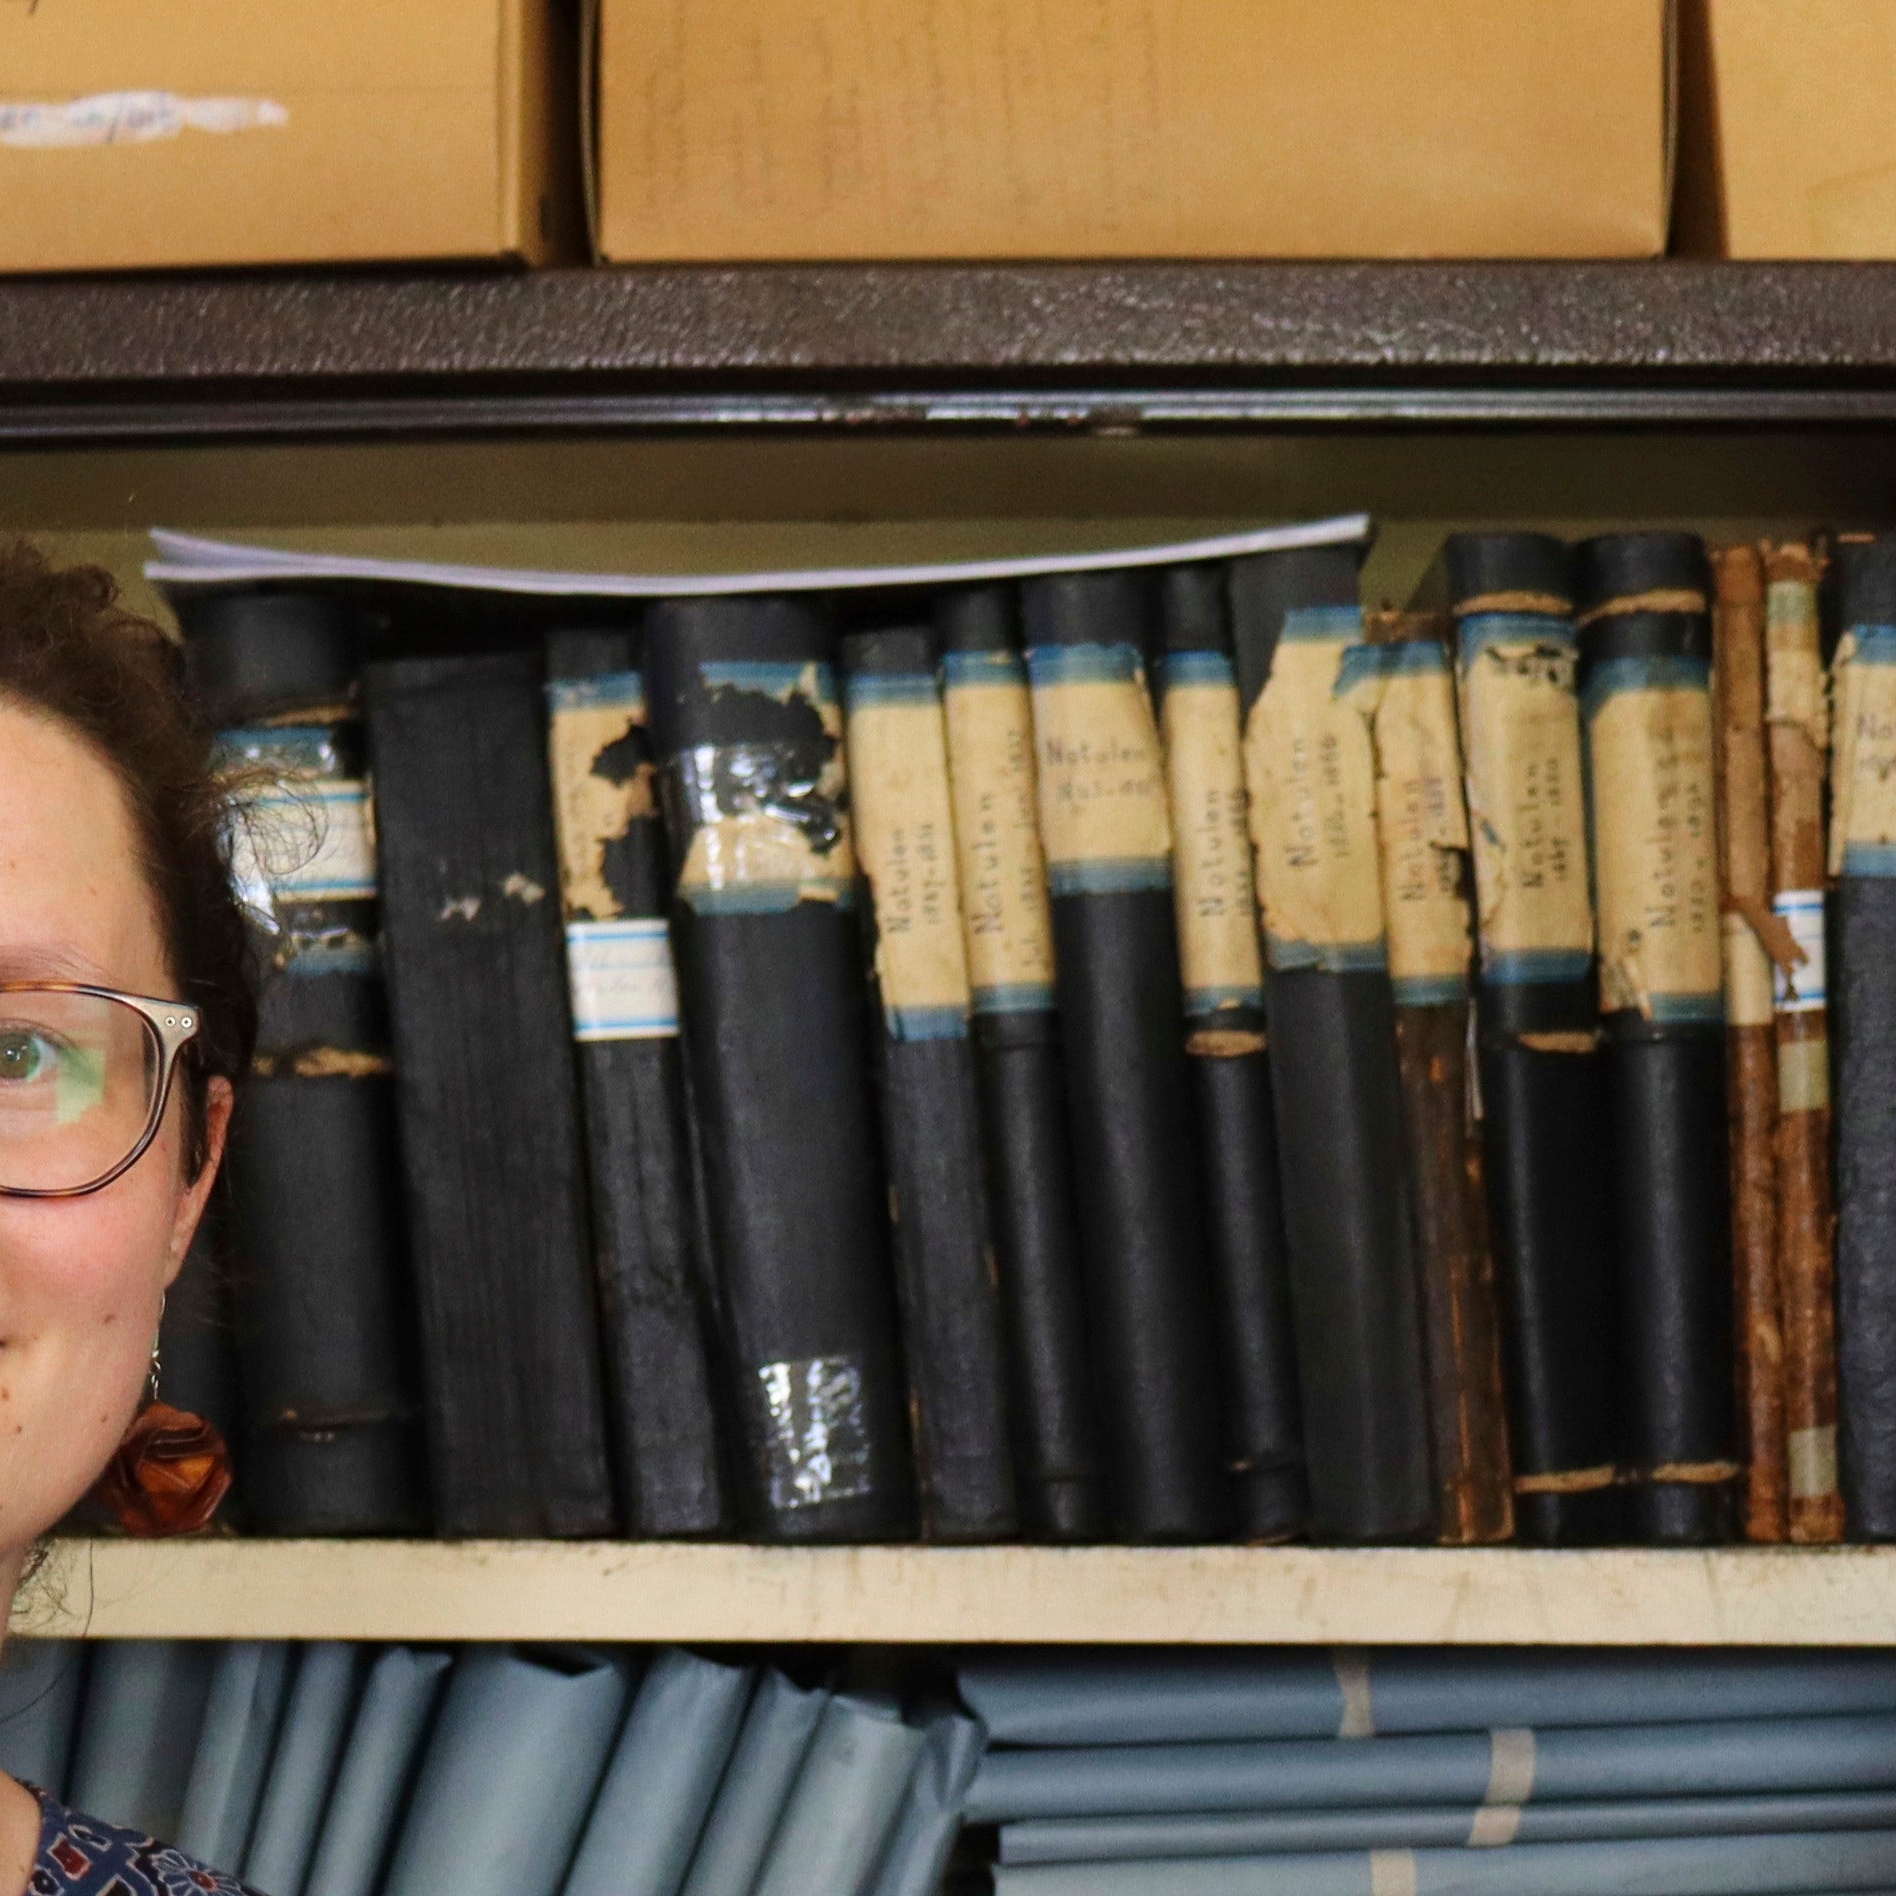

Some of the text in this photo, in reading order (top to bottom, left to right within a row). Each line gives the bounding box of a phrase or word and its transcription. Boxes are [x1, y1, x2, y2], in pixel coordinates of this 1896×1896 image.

[1046, 739, 1147, 765] Notulen
[1285, 738, 1317, 868] Notulen
[886, 826, 912, 935] Notulen
[969, 792, 1003, 935] Notulen
[1196, 791, 1226, 917] Notulen
[1398, 780, 1424, 900] Notulen
[1519, 764, 1544, 889] Notulen
[1646, 783, 1678, 928] Notulen
